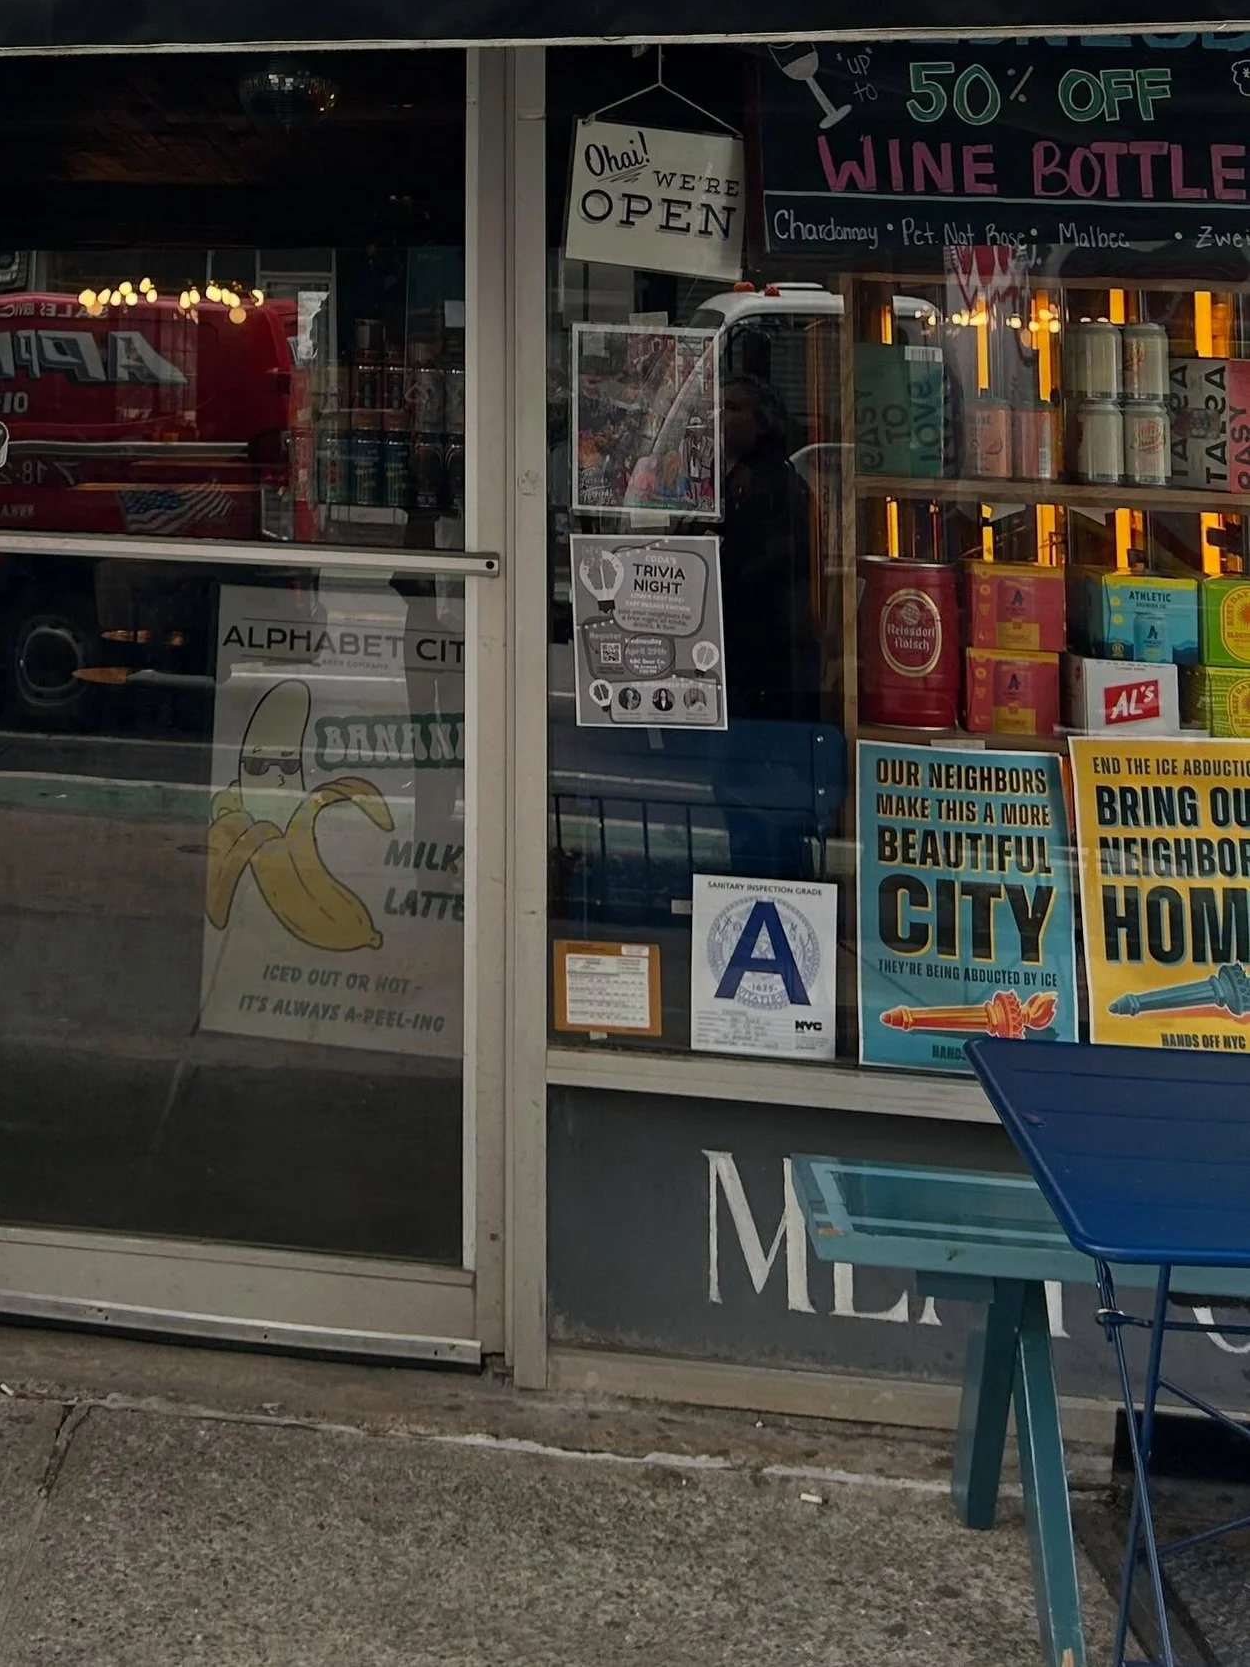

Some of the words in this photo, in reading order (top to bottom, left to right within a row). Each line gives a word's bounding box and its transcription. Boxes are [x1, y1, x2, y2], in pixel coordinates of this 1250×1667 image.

[1058, 67, 1172, 122] OFF
[584, 130, 650, 177] Ohai!
[817, 134, 998, 194] WINE
[1032, 140, 1247, 201] BOTTLE
[653, 170, 740, 197] WE'RE
[578, 189, 737, 241] OPEN
[1058, 221, 1131, 248] Malbec
[632, 563, 686, 581] TRIVIA
[633, 578, 683, 595] NIGHT
[1129, 590, 1172, 603] ATHLETIC
[223, 625, 405, 659] ALPHABET
[876, 758, 922, 788] OUR
[929, 762, 1048, 796] NEIGHBORS
[1092, 757, 1121, 775] END
[1125, 757, 1151, 775] THE
[1156, 758, 1178, 776] ICE
[876, 793, 931, 819] MAKE
[936, 798, 979, 826] THIS
[983, 802, 996, 826] A
[1001, 802, 1051, 828] MORE
[1095, 785, 1200, 828] BRING
[877, 825, 1054, 878] BEAUTIFUL
[708, 881, 745, 891] SANITARY
[747, 884, 793, 895] INSPECTION
[795, 887, 823, 896] GRADE
[878, 873, 1057, 965] CITY
[714, 901, 812, 1007] A
[262, 963, 302, 983] ICED
[307, 969, 343, 987] OUT
[346, 972, 370, 991] OR
[375, 976, 411, 994] HOT
[878, 958, 922, 976] THEY'RE
[926, 963, 960, 980] BEING
[963, 967, 1020, 985] ABDUCTED
[1024, 972, 1037, 986] BY
[1041, 973, 1058, 987] ICE
[238, 994, 269, 1012] IT'S
[273, 997, 341, 1020] ALWAYS
[795, 1020, 823, 1031] NYC
[1161, 1032, 1199, 1048] HANDS
[1202, 1033, 1221, 1048] OFF
[1223, 1034, 1247, 1049] NYC
[932, 1044, 967, 1061] HAND
